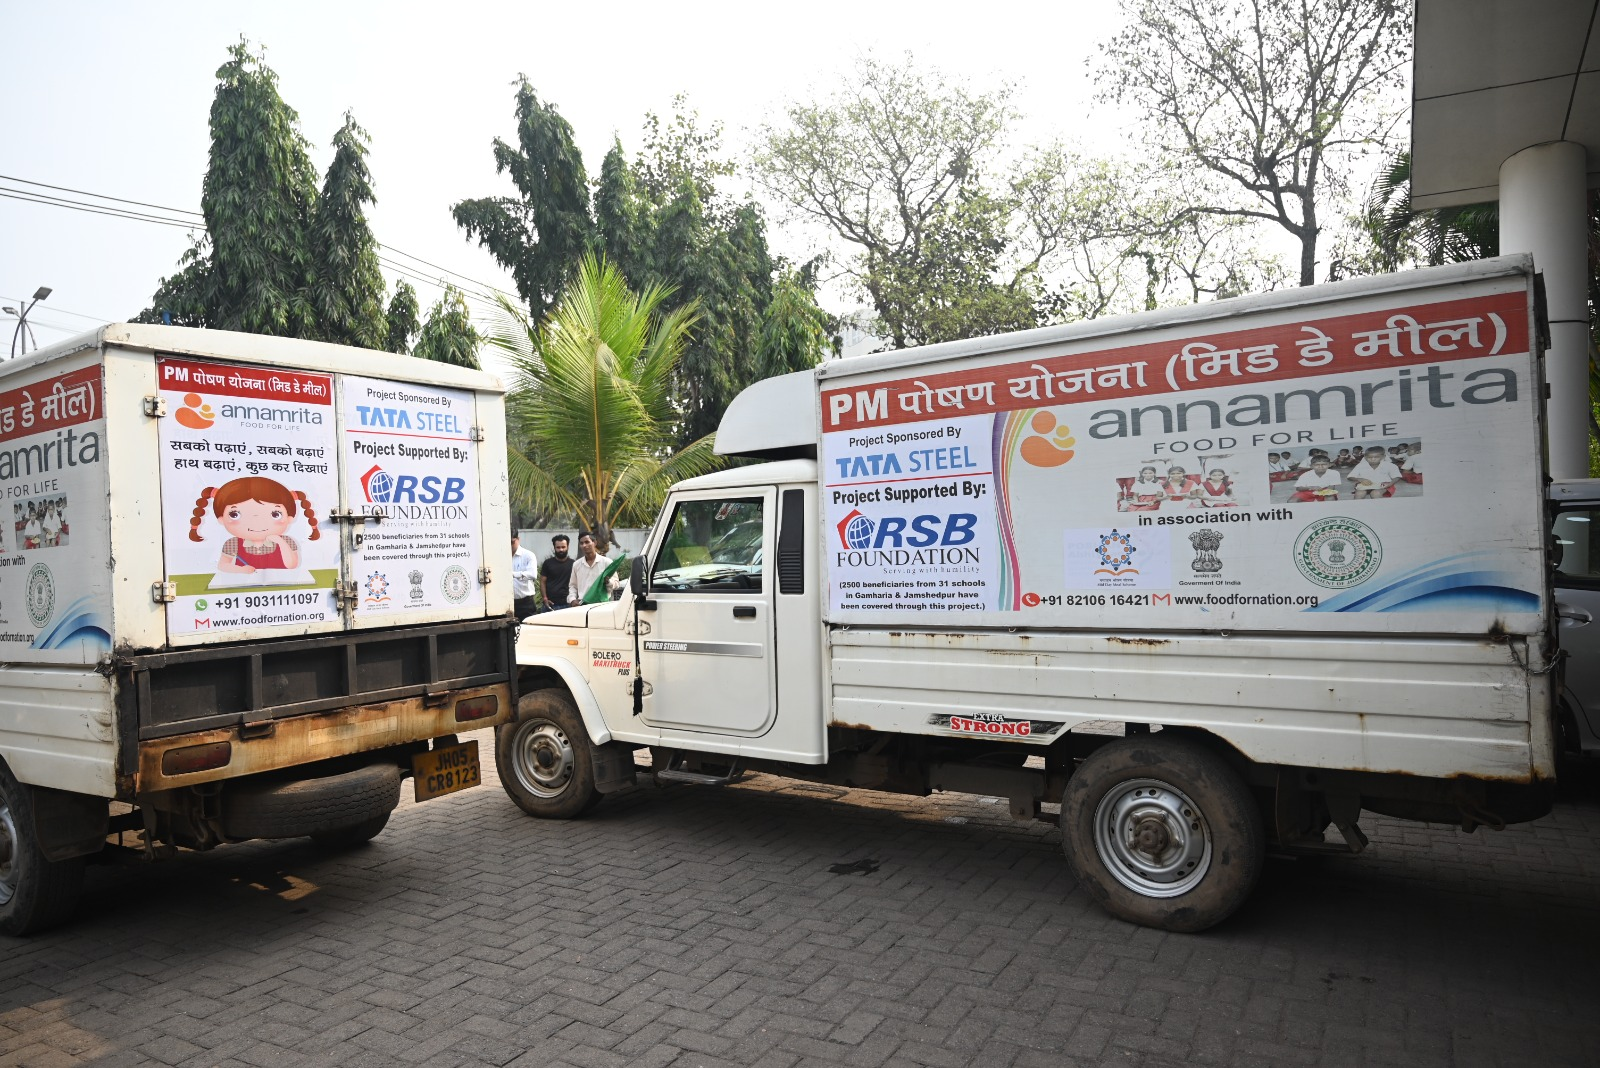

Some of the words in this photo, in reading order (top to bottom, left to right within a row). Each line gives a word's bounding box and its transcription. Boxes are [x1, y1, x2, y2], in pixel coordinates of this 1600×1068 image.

[829, 388, 889, 426] PM
[898, 380, 996, 414] पोषण
[1007, 361, 1148, 401] योजना
[1165, 341, 1280, 391] (मिड
[1295, 326, 1334, 367] डे
[1351, 312, 1508, 358] मील)
[164, 365, 188, 383] PM
[193, 368, 225, 387] पोषण
[229, 372, 266, 391] योजना
[268, 376, 291, 393] (मिड
[293, 378, 301, 394] डे
[302, 380, 327, 397] मील)
[367, 387, 397, 401] Project
[398, 391, 440, 405] Sponsored
[442, 396, 452, 408] By
[1088, 365, 1519, 441] annamrita
[0, 405, 15, 434] ड
[20, 390, 35, 428] डे
[41, 381, 95, 421] मील)
[221, 404, 323, 425] annamrita
[240, 421, 264, 429] FOOD
[356, 405, 412, 429] TATA
[416, 411, 463, 433] STEEL
[849, 435, 884, 448] Project
[886, 428, 944, 445] Sponsored
[947, 426, 962, 438] By
[1153, 437, 1238, 455] FOOD
[1252, 429, 1313, 447] FOR
[1329, 422, 1399, 441] LIFE
[170, 439, 210, 453] सबको
[256, 443, 292, 457] सबको
[353, 440, 396, 458] Project
[398, 443, 450, 460] Supported
[453, 447, 468, 463] By:
[174, 458, 199, 469] हाथ
[245, 461, 269, 474] कुछ
[271, 462, 290, 473] कर
[835, 453, 902, 479] TATA
[908, 445, 977, 473] STEEL
[7, 484, 30, 499] FOR
[34, 478, 58, 494] LIFE
[392, 475, 466, 504] RSB
[832, 489, 881, 506] Project
[884, 482, 958, 503] Supported
[962, 480, 987, 499] By:
[360, 504, 468, 520] FOUNDATION
[1138, 514, 1153, 527] in
[1157, 510, 1251, 526] association
[1256, 508, 1293, 522] with
[872, 513, 978, 549] RSB
[381, 553, 408, 561] covered
[409, 552, 433, 560] through
[837, 547, 980, 567] FOUNDATION
[883, 567, 916, 575] Serving
[919, 566, 938, 574] with
[941, 565, 980, 574] humility
[839, 581, 861, 589] (2500
[862, 580, 914, 588] beneficiaries
[938, 579, 949, 587] 31
[951, 579, 986, 587] schools
[215, 596, 239, 609] +91
[244, 592, 320, 608] 9031111097
[845, 591, 853, 599] in
[855, 591, 893, 599] Gamharia
[903, 591, 955, 600] Jamshedpur
[957, 590, 979, 598] have
[1040, 594, 1063, 606] +91
[1066, 594, 1106, 606] 82106
[1110, 593, 1150, 606] 16421
[1174, 593, 1319, 608] www.foodfornation.org
[861, 602, 893, 610] covered
[895, 602, 926, 611] through
[928, 602, 946, 610] this
[947, 602, 986, 611] project.)
[212, 611, 325, 628] www.foodfornation.org
[592, 651, 621, 660] BOLERO
[645, 641, 663, 651] POWER
[664, 642, 688, 651] STEERING
[592, 660, 631, 668] MAXITRUCK
[617, 668, 630, 676] PLUS
[950, 716, 1031, 736] STRONG
[973, 712, 1005, 722] EXTRA
[435, 749, 468, 772] JH05
[427, 765, 478, 793] CR8123
